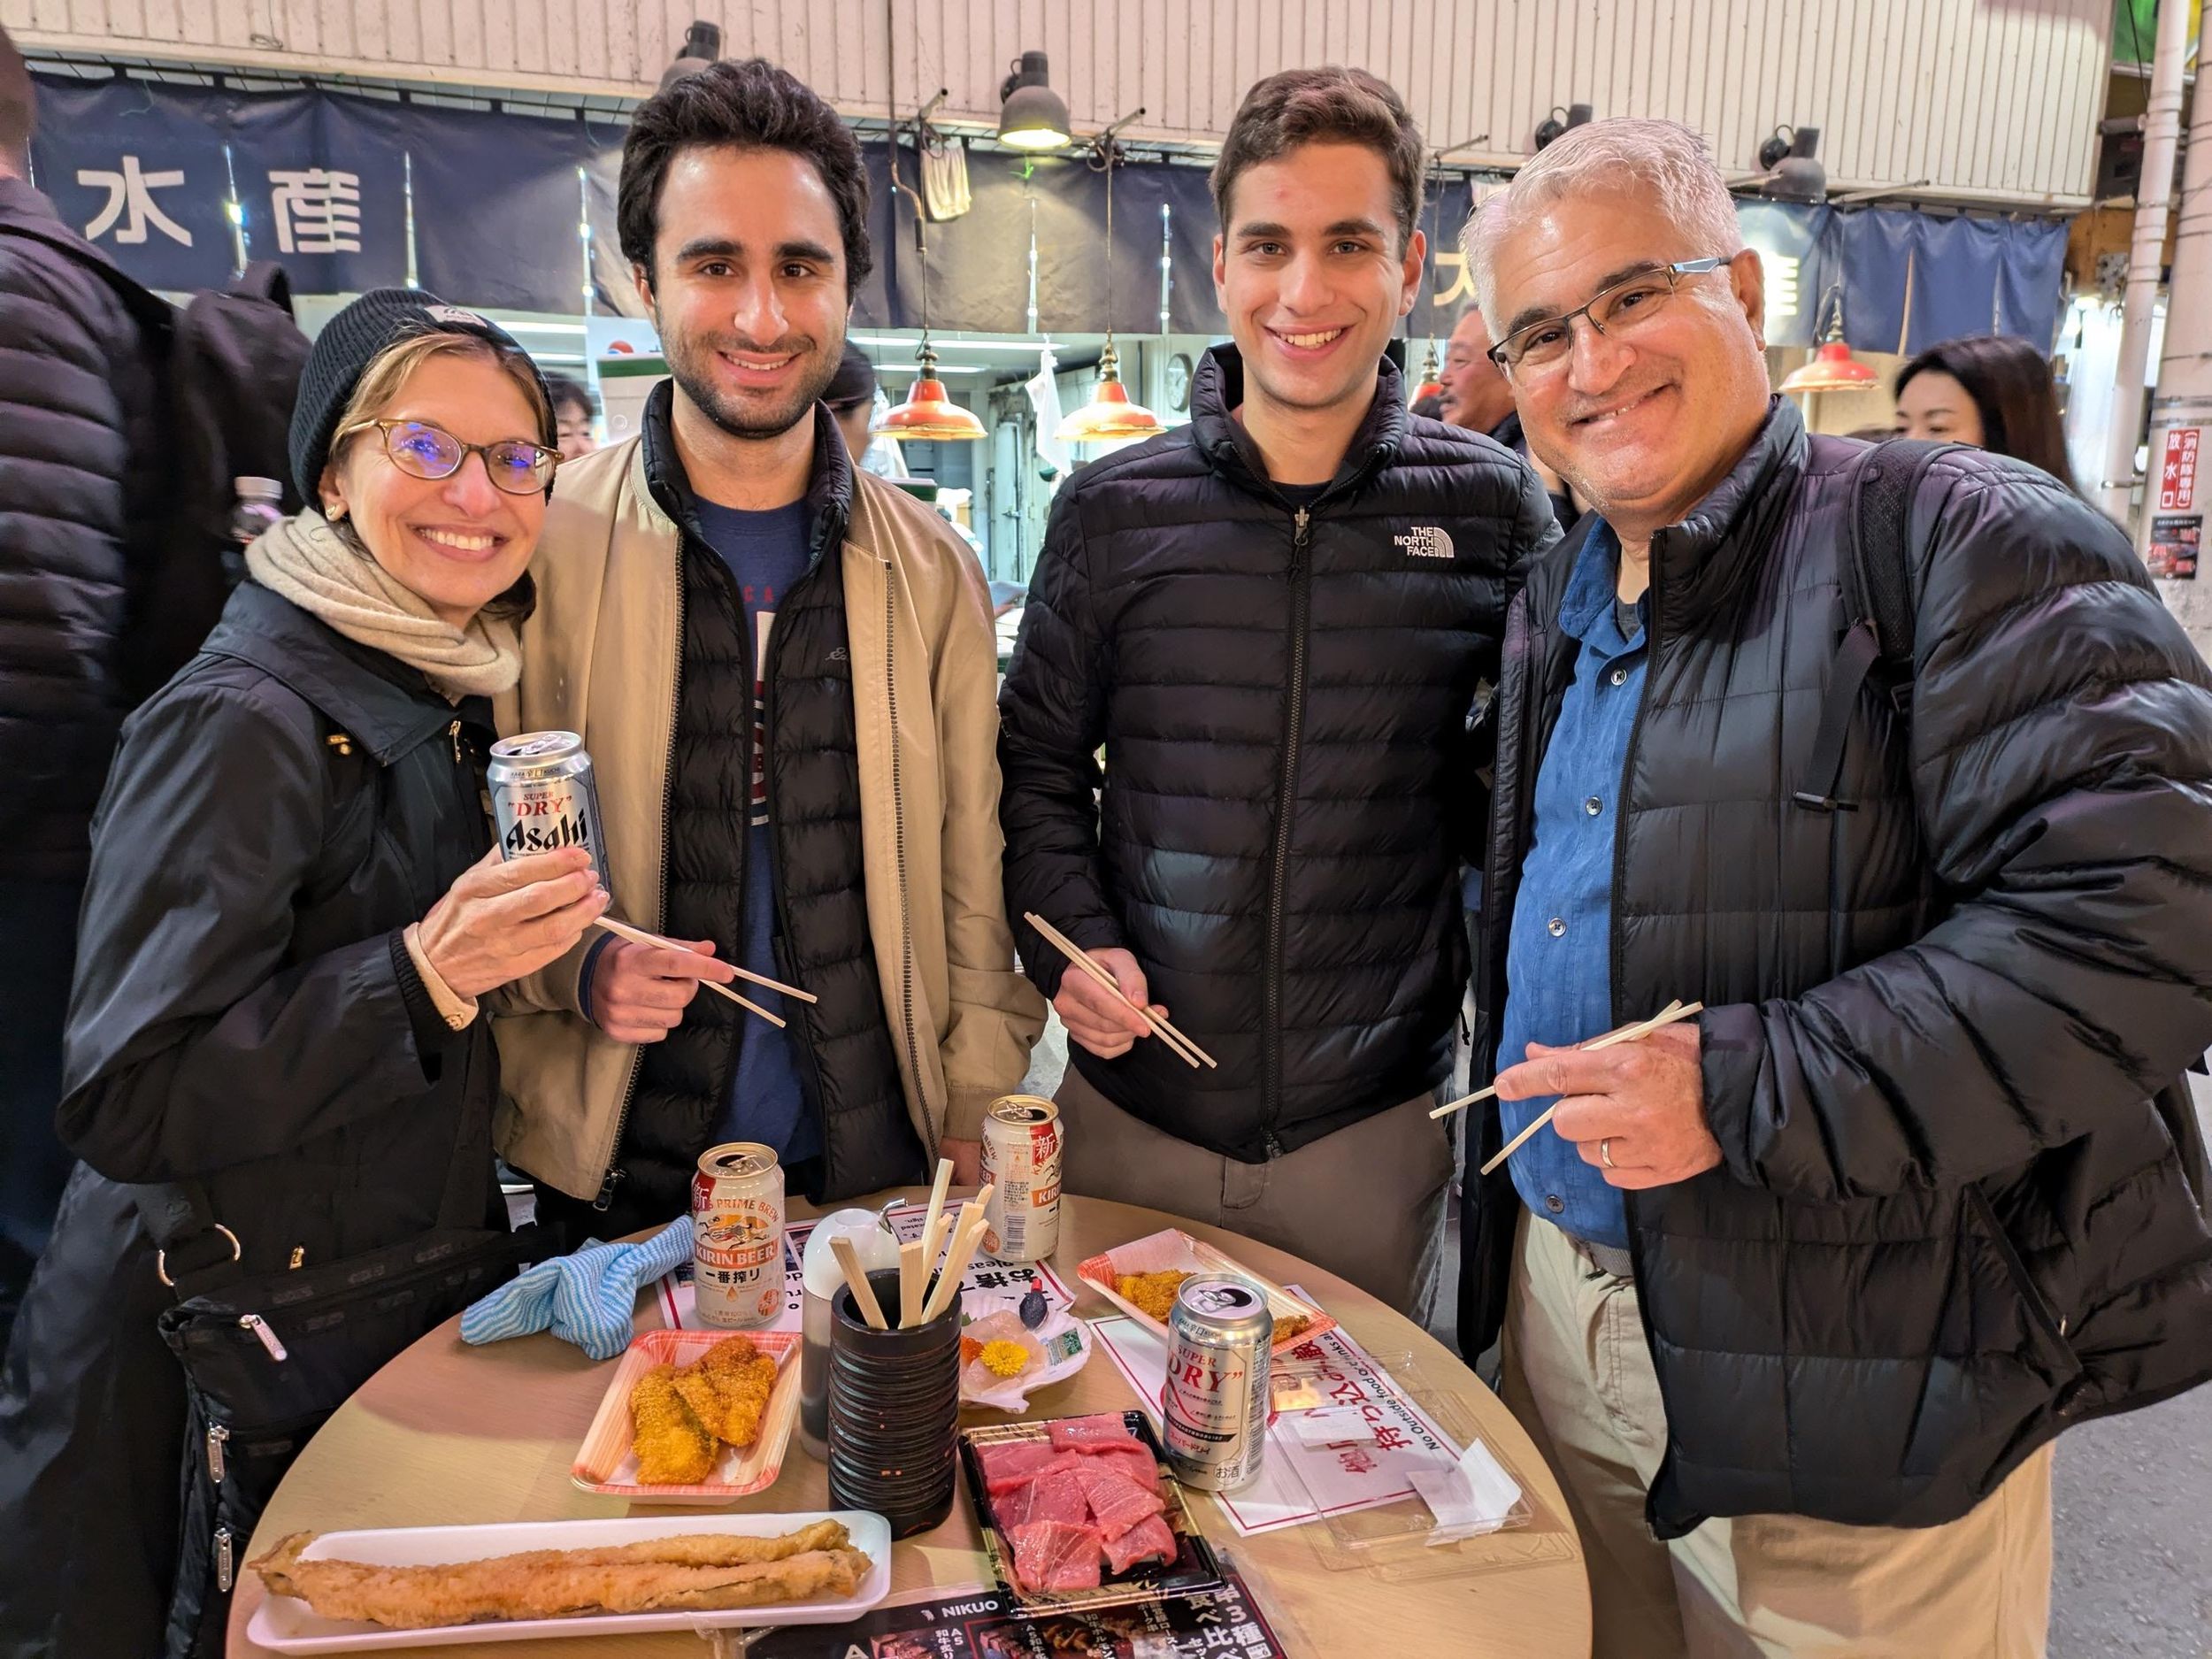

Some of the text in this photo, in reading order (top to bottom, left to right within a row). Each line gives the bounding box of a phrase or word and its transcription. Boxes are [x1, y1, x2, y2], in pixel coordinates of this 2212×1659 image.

[77, 155, 361, 254] 水産
[2162, 433, 2181, 507] 放水口
[1394, 535, 1433, 546] NORTH
[1410, 526, 1433, 536] THE
[1407, 546, 1434, 557] FACE
[523, 791, 553, 801] SUPER
[506, 808, 588, 852] Asahi
[982, 1135, 998, 1161] BREW
[1036, 1133, 1056, 1160] 新
[693, 1181, 710, 1211] 新
[1038, 1182, 1062, 1204] KIRI
[716, 1198, 755, 1210] PRIME
[757, 1201, 780, 1224] BREW
[695, 1242, 775, 1265] KIRIN BEER
[705, 1267, 761, 1284] 一番搾り
[1178, 1344, 1217, 1368] SUPER
[1291, 1339, 1413, 1452] 持ち込み厳
[1363, 1377, 1386, 1400] food
[1386, 1398, 1425, 1435] Outside
[1422, 1434, 1441, 1451] No
[1215, 1464, 1240, 1479] お酒
[941, 1600, 998, 1618] NIKUO
